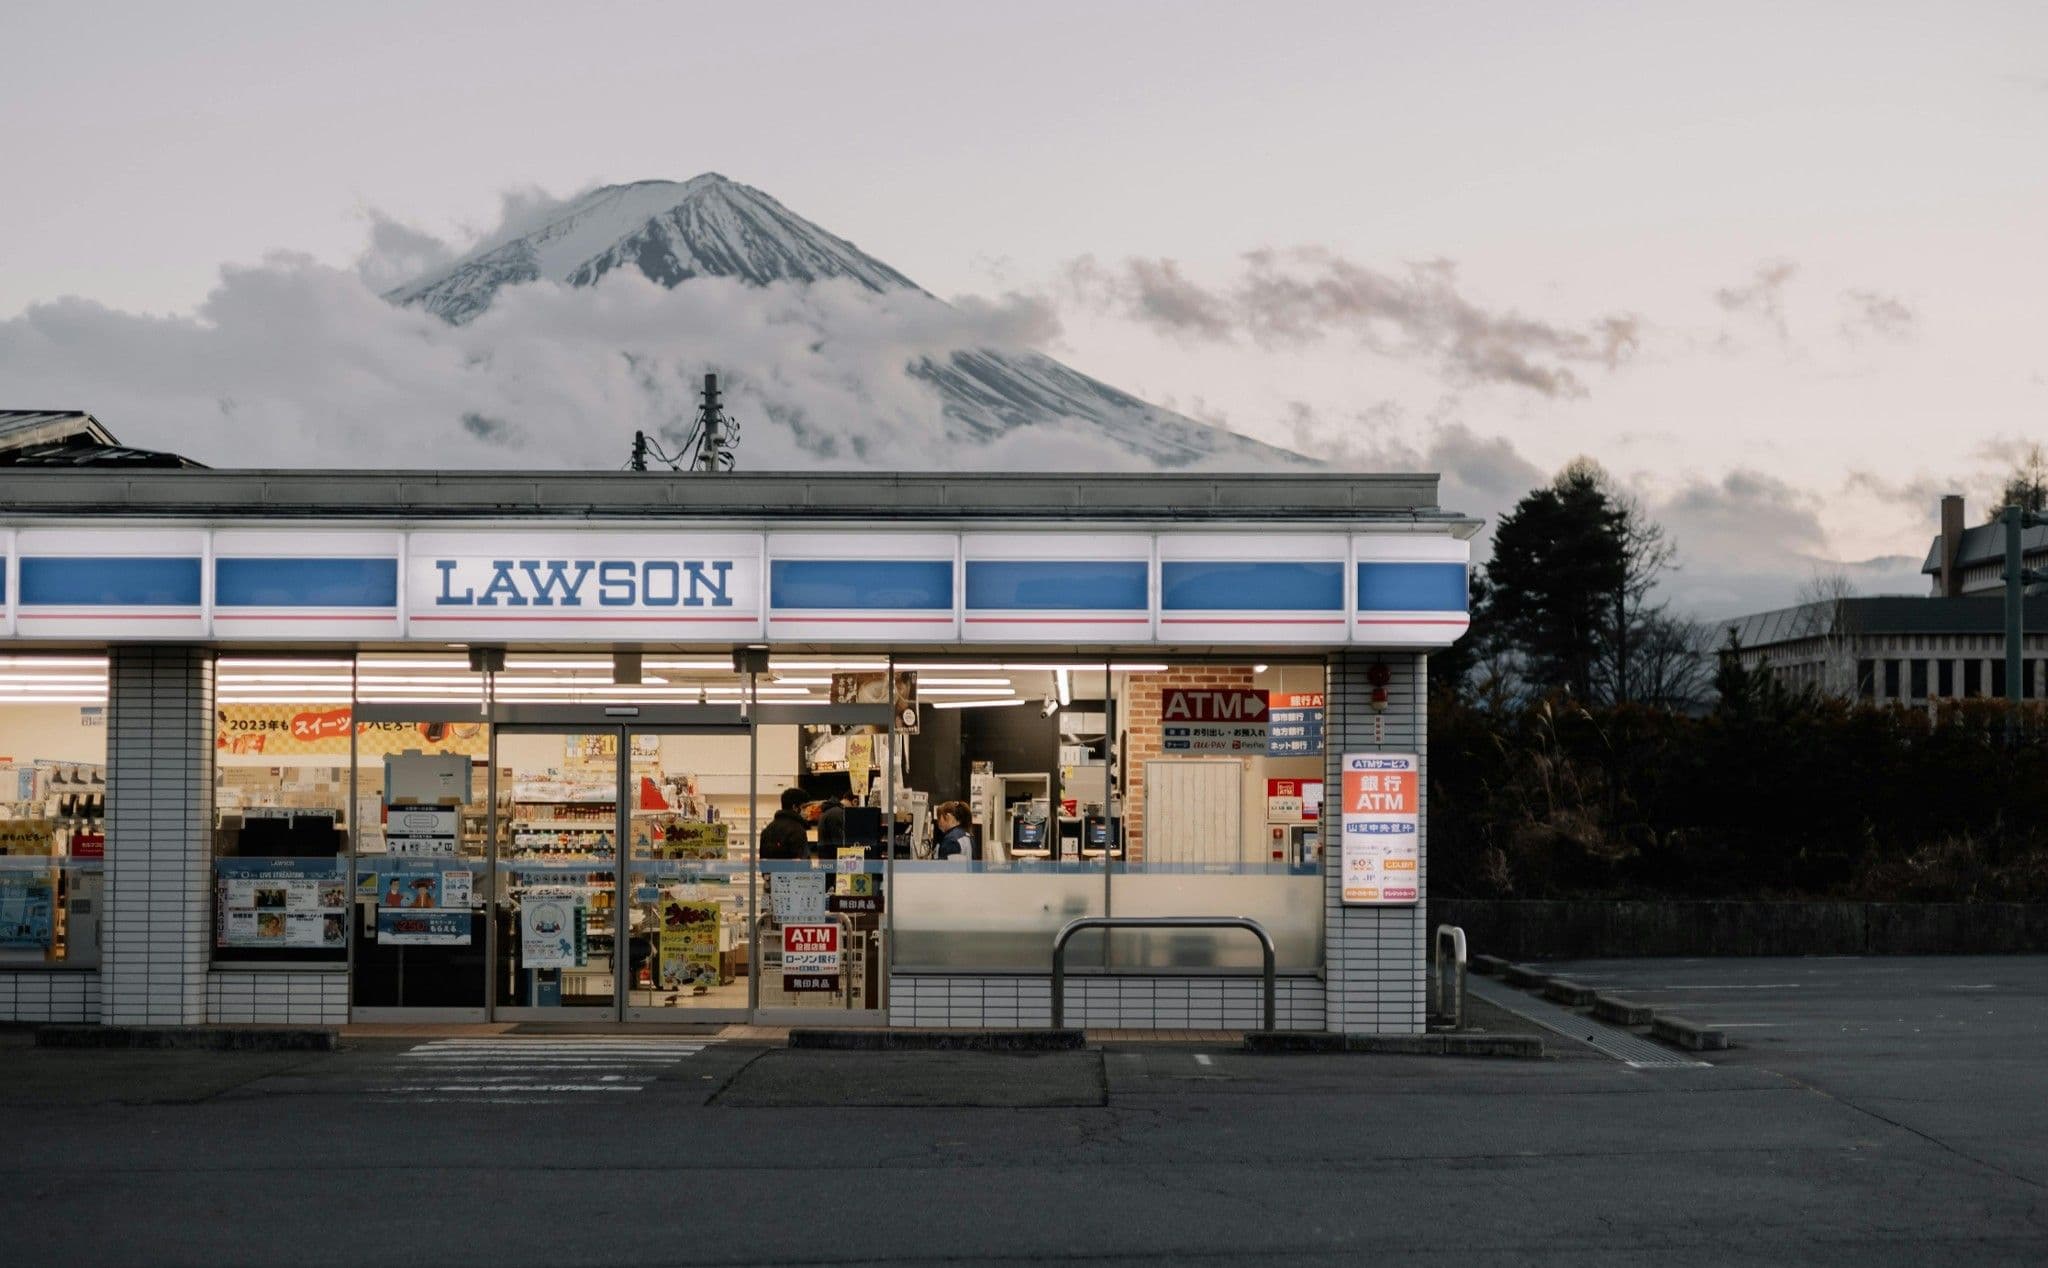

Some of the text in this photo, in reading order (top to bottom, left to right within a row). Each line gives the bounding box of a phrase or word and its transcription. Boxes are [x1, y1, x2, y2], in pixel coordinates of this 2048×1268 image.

[436, 560, 733, 606] LAWSON
[1165, 692, 1242, 719] ATM
[230, 719, 289, 732] 2023年も
[294, 716, 351, 736] スイーツ
[1271, 741, 1308, 751] ネット銀行
[1354, 759, 1408, 769] ATMサービス
[1360, 775, 1402, 792] 銀行
[1356, 793, 1404, 810] ATM
[839, 899, 876, 910] 無印良品
[791, 929, 831, 943] ATM
[785, 955, 836, 964] ローソン銀行
[793, 978, 830, 988] 無印良品
